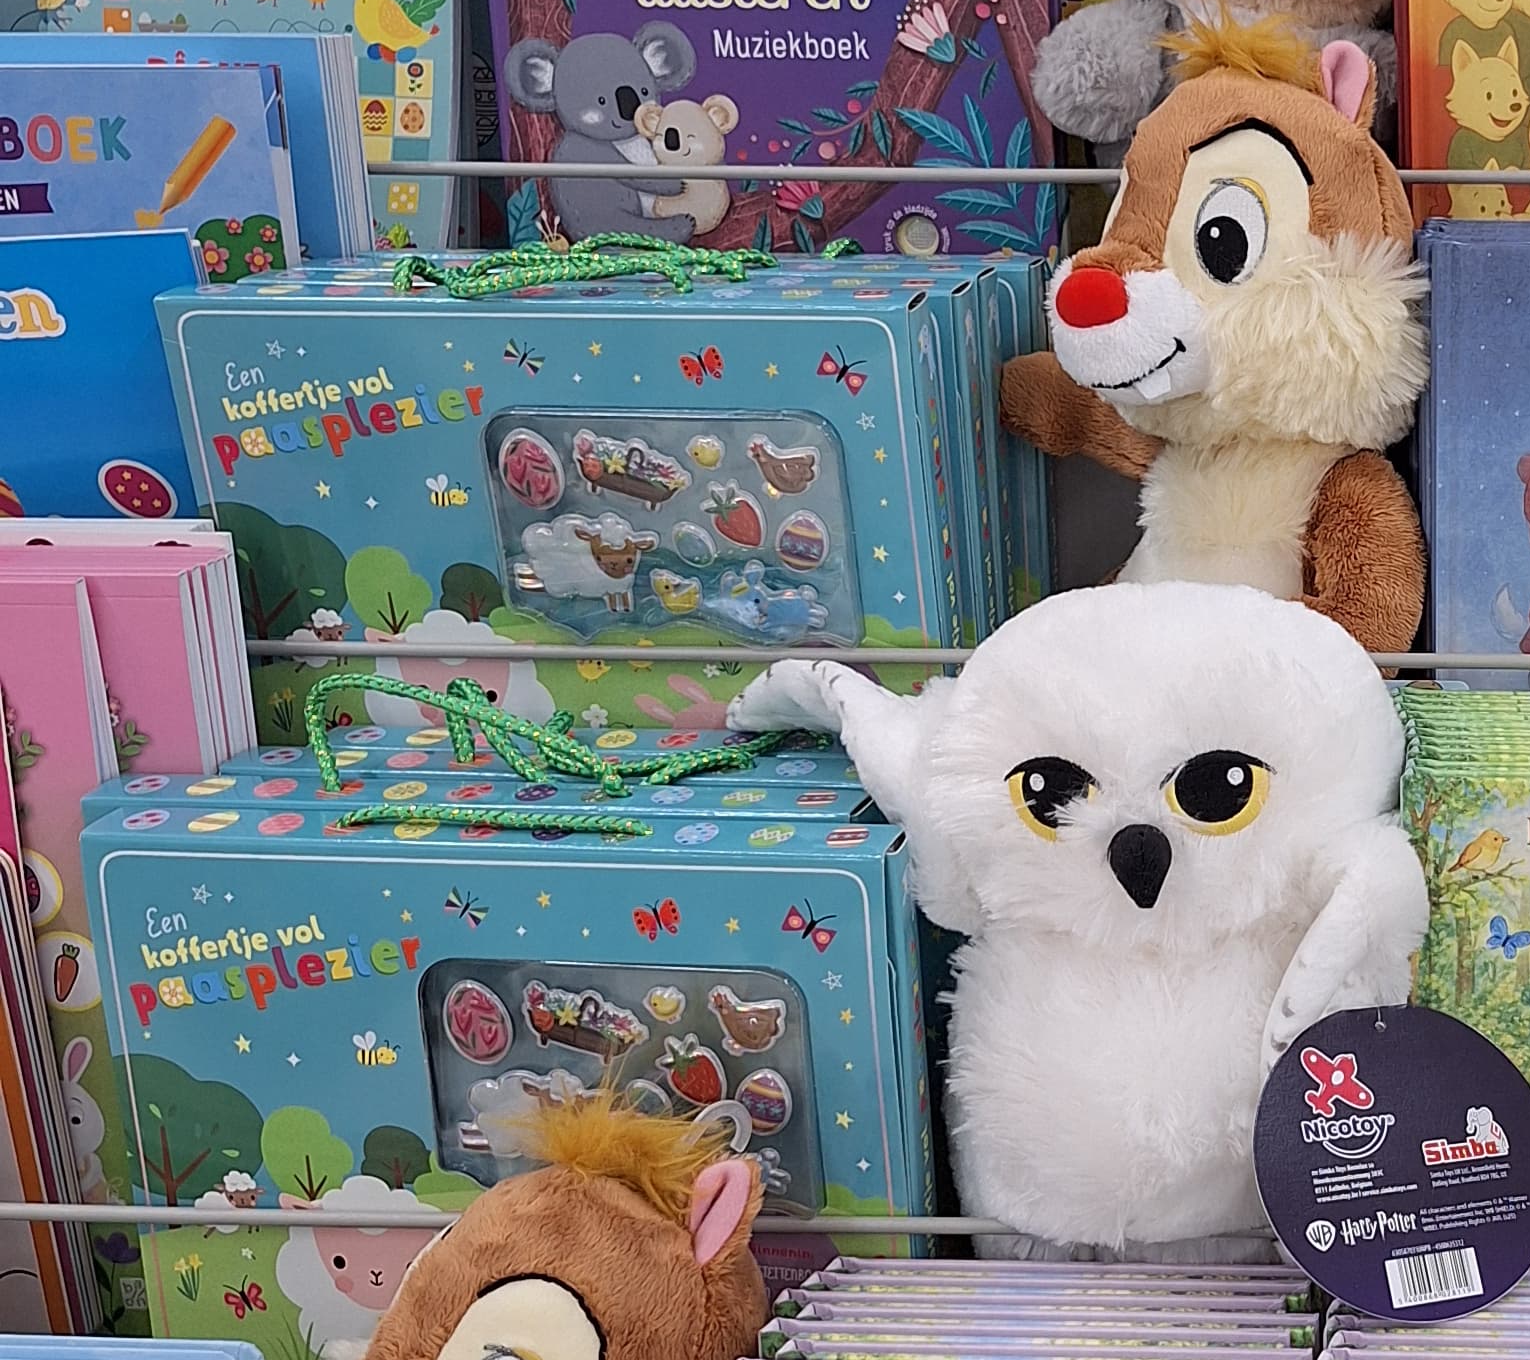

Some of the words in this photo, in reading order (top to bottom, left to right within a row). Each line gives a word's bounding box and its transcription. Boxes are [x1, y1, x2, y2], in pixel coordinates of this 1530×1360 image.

[713, 29, 871, 61] Muziekboek
[225, 362, 265, 391] Een
[222, 379, 342, 422] koffertje
[349, 367, 394, 397] vol
[212, 384, 484, 476] paasplezier
[146, 907, 187, 938] Een
[140, 927, 269, 970] koffertje
[277, 914, 325, 947] vol
[129, 934, 420, 1027] paasplezier
[1301, 1114, 1389, 1143] Nicotoy
[1424, 1141, 1500, 1165] Simba
[1340, 1216, 1378, 1246] Harry
[1376, 1210, 1417, 1241] Potter
